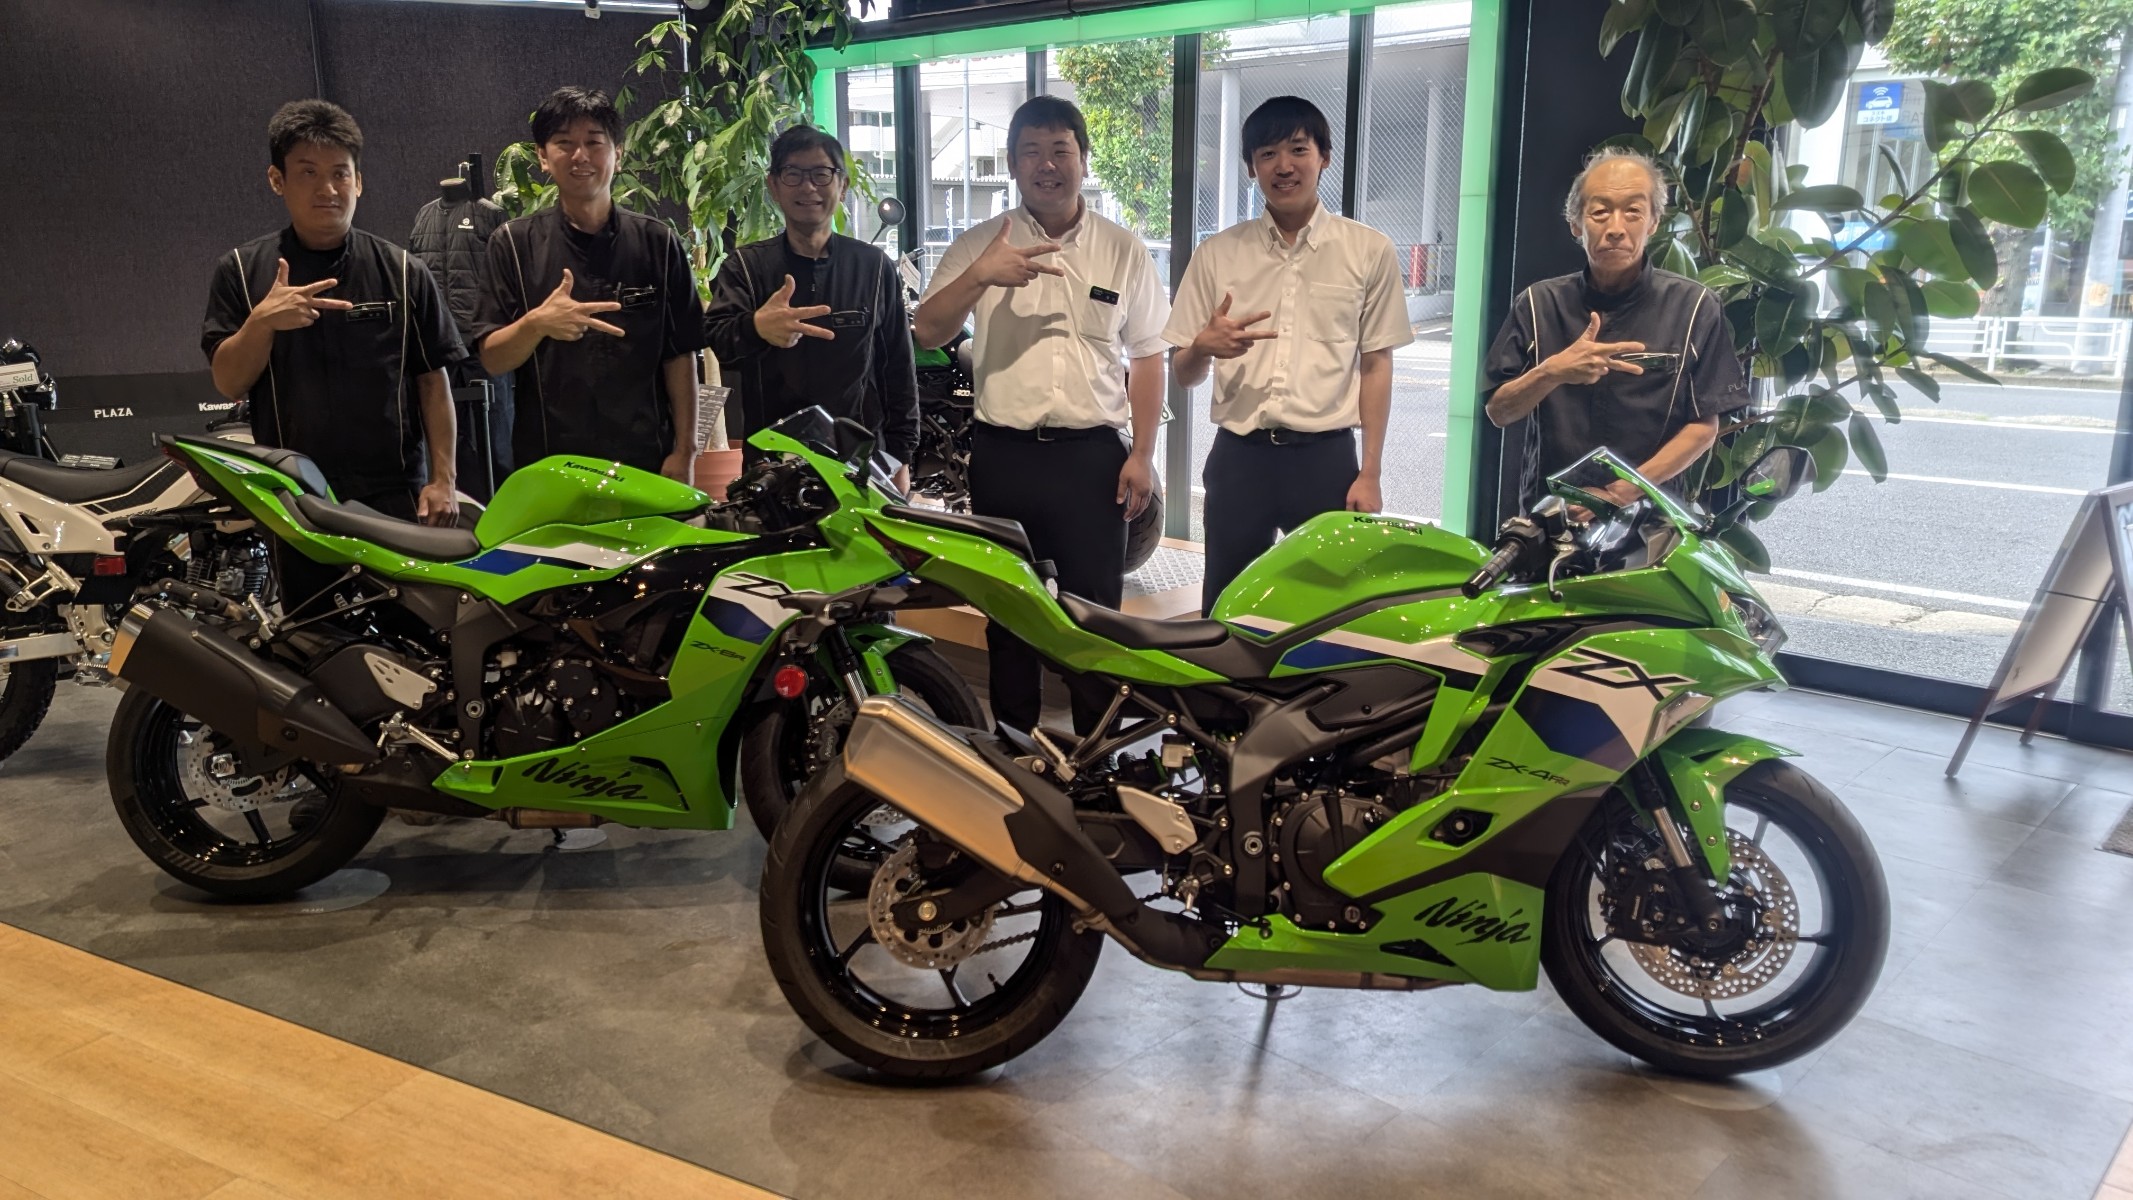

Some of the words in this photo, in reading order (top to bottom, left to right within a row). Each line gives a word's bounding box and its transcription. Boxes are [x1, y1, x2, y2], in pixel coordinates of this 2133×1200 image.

[12, 374, 33, 384] Sold
[94, 407, 134, 419] PLAZA
[198, 402, 237, 412] Kawas
[563, 461, 625, 482] Kawasaki
[1547, 646, 1692, 702] ZX
[522, 757, 648, 798] Ninja
[1484, 756, 1570, 787] ZX-4RR
[1413, 896, 1532, 946] Ninja
